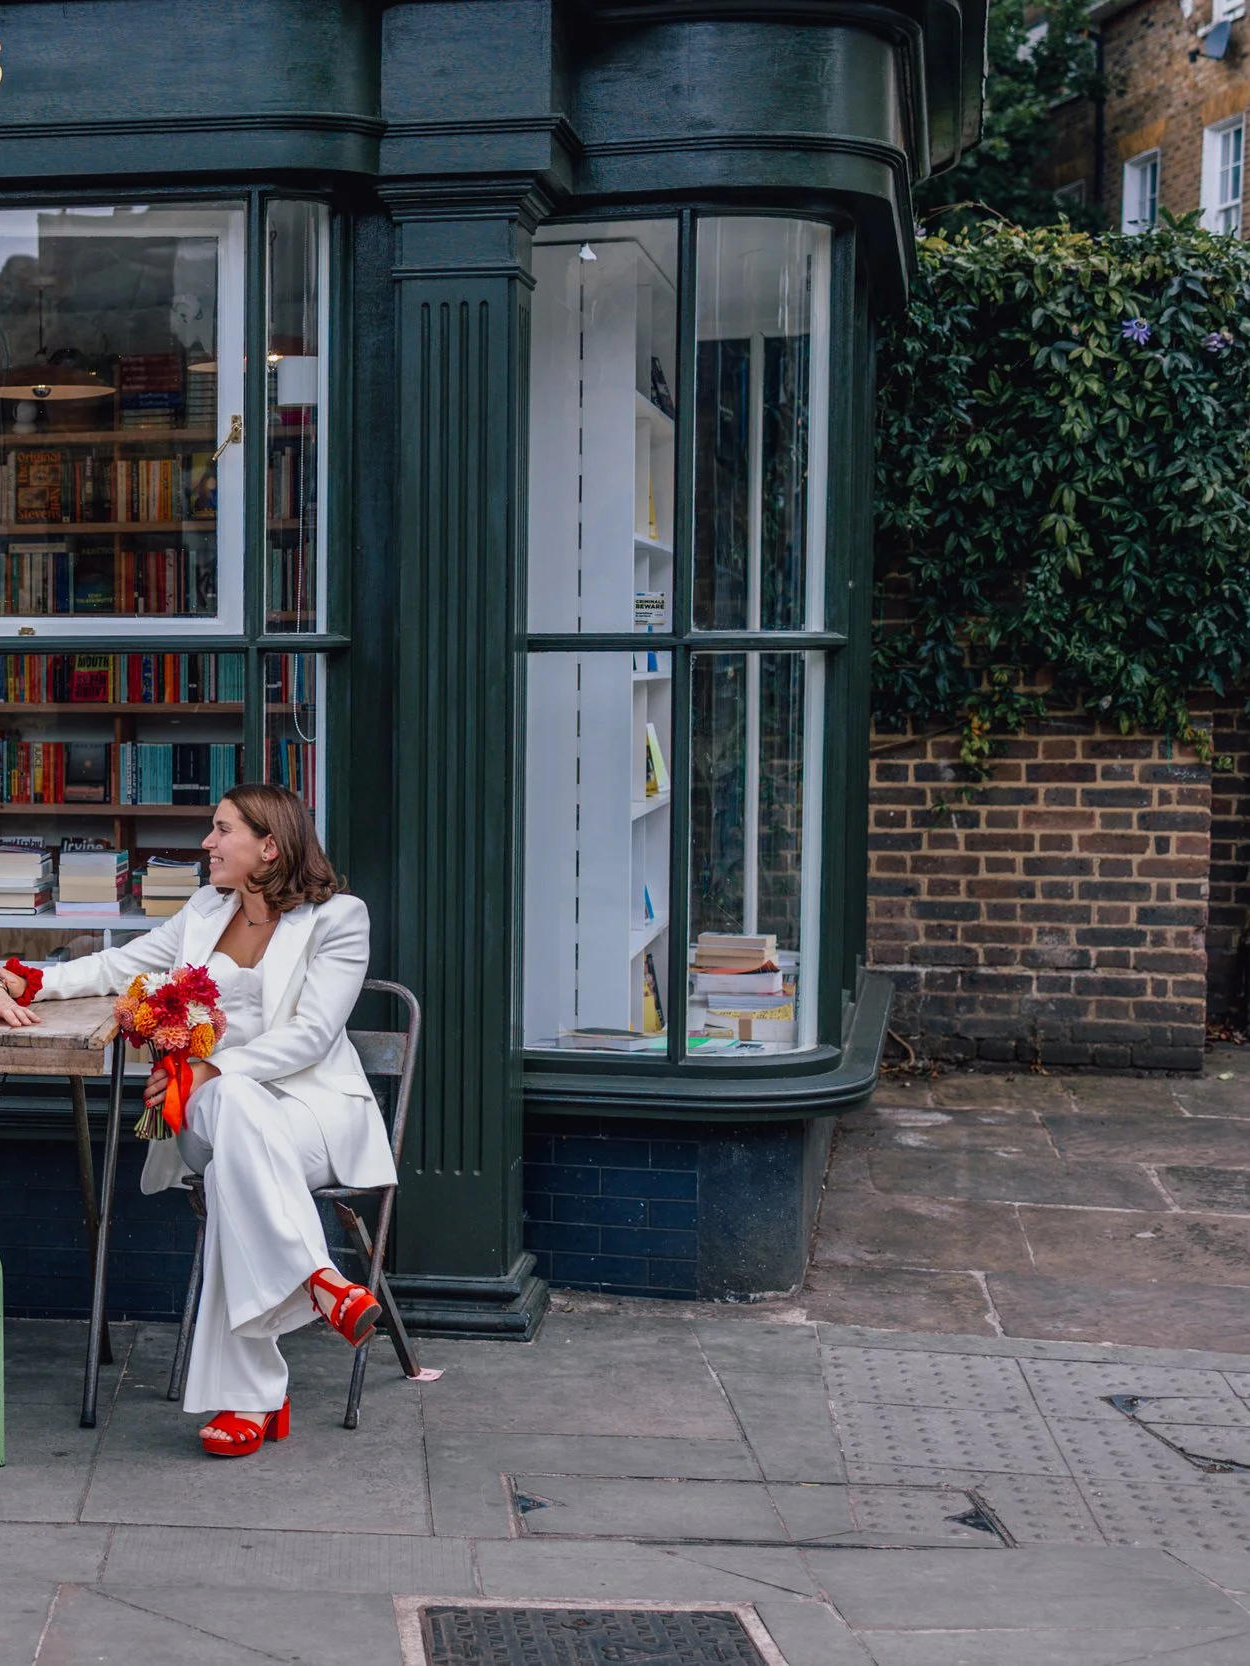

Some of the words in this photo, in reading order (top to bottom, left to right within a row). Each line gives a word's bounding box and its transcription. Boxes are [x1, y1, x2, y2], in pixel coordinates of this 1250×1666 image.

[17, 451, 61, 465] Original
[17, 508, 62, 520] Stevens
[78, 655, 109, 667] MOUTH
[34, 746, 42, 768] JUICE
[63, 840, 104, 851] Irvine
